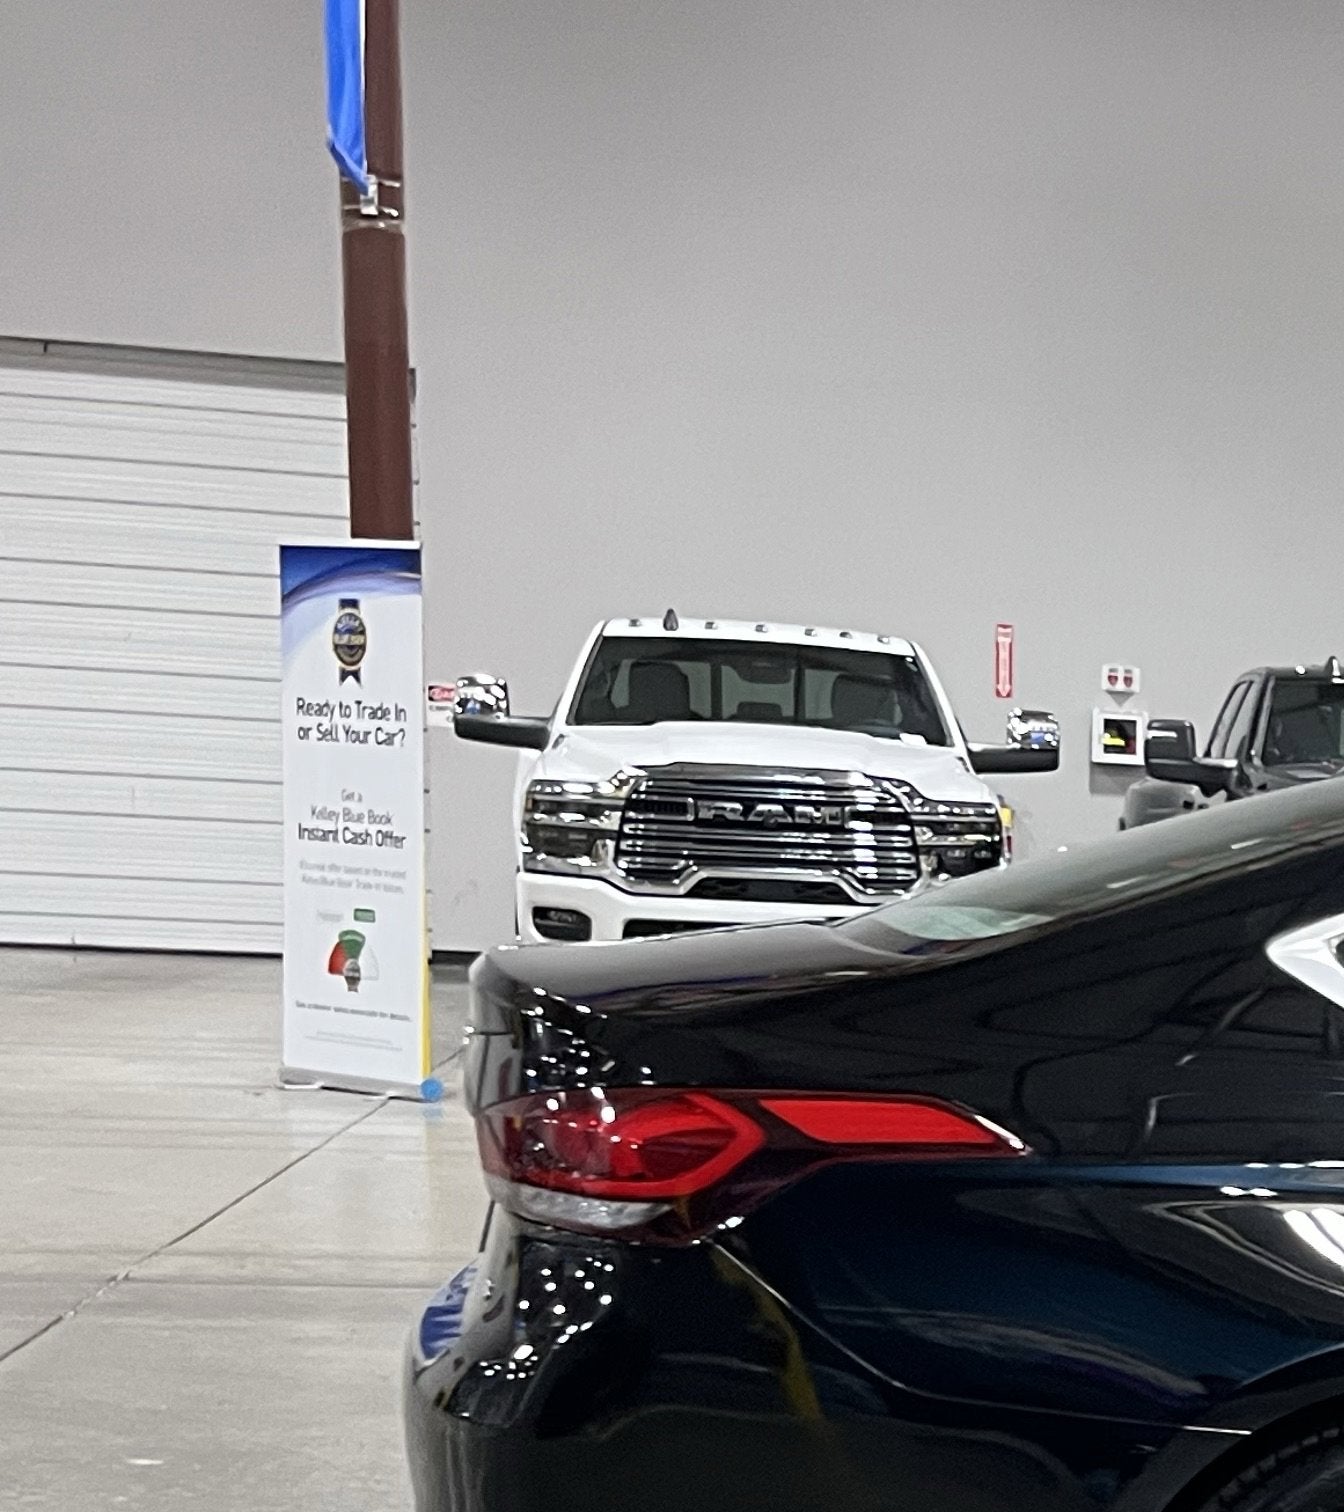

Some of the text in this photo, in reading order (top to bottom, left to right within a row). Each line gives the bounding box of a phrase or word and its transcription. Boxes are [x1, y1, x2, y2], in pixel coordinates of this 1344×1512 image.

[296, 696, 407, 722] Ready to Trade In
[298, 722, 406, 747] or Sell Your Car?
[697, 801, 843, 824] RAM
[298, 822, 407, 849] Instant Cash Offer
